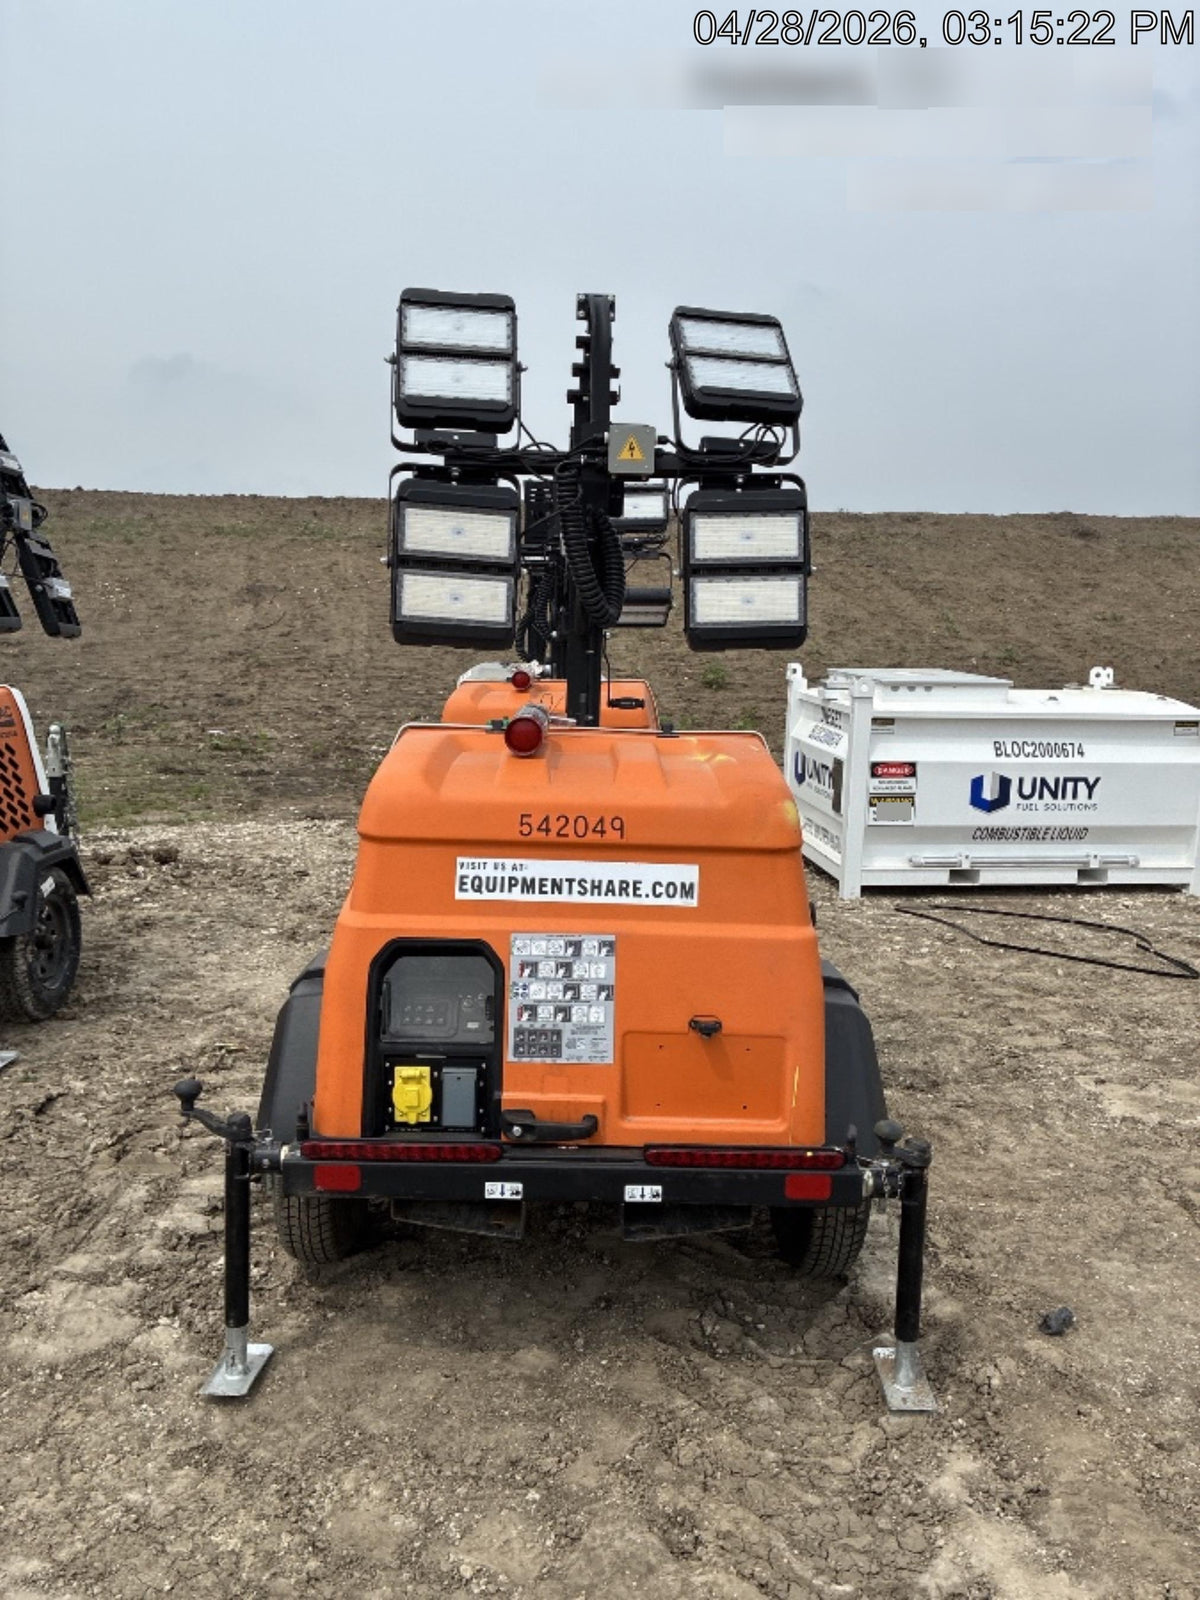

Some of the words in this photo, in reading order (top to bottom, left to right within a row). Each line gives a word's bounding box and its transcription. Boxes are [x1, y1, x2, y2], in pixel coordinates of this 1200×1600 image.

[994, 740, 1084, 758] BLOC2000674
[1017, 776, 1101, 800] UNITY
[1016, 803, 1039, 812] FUEL
[1043, 803, 1098, 812] SOLUTIONS
[519, 813, 625, 840] 542049
[972, 826, 1051, 841] COMBUSTIBLE
[459, 861, 488, 870] VISIT
[493, 862, 506, 872] US
[458, 874, 695, 900] EQUIPMENTSHARE.COM
